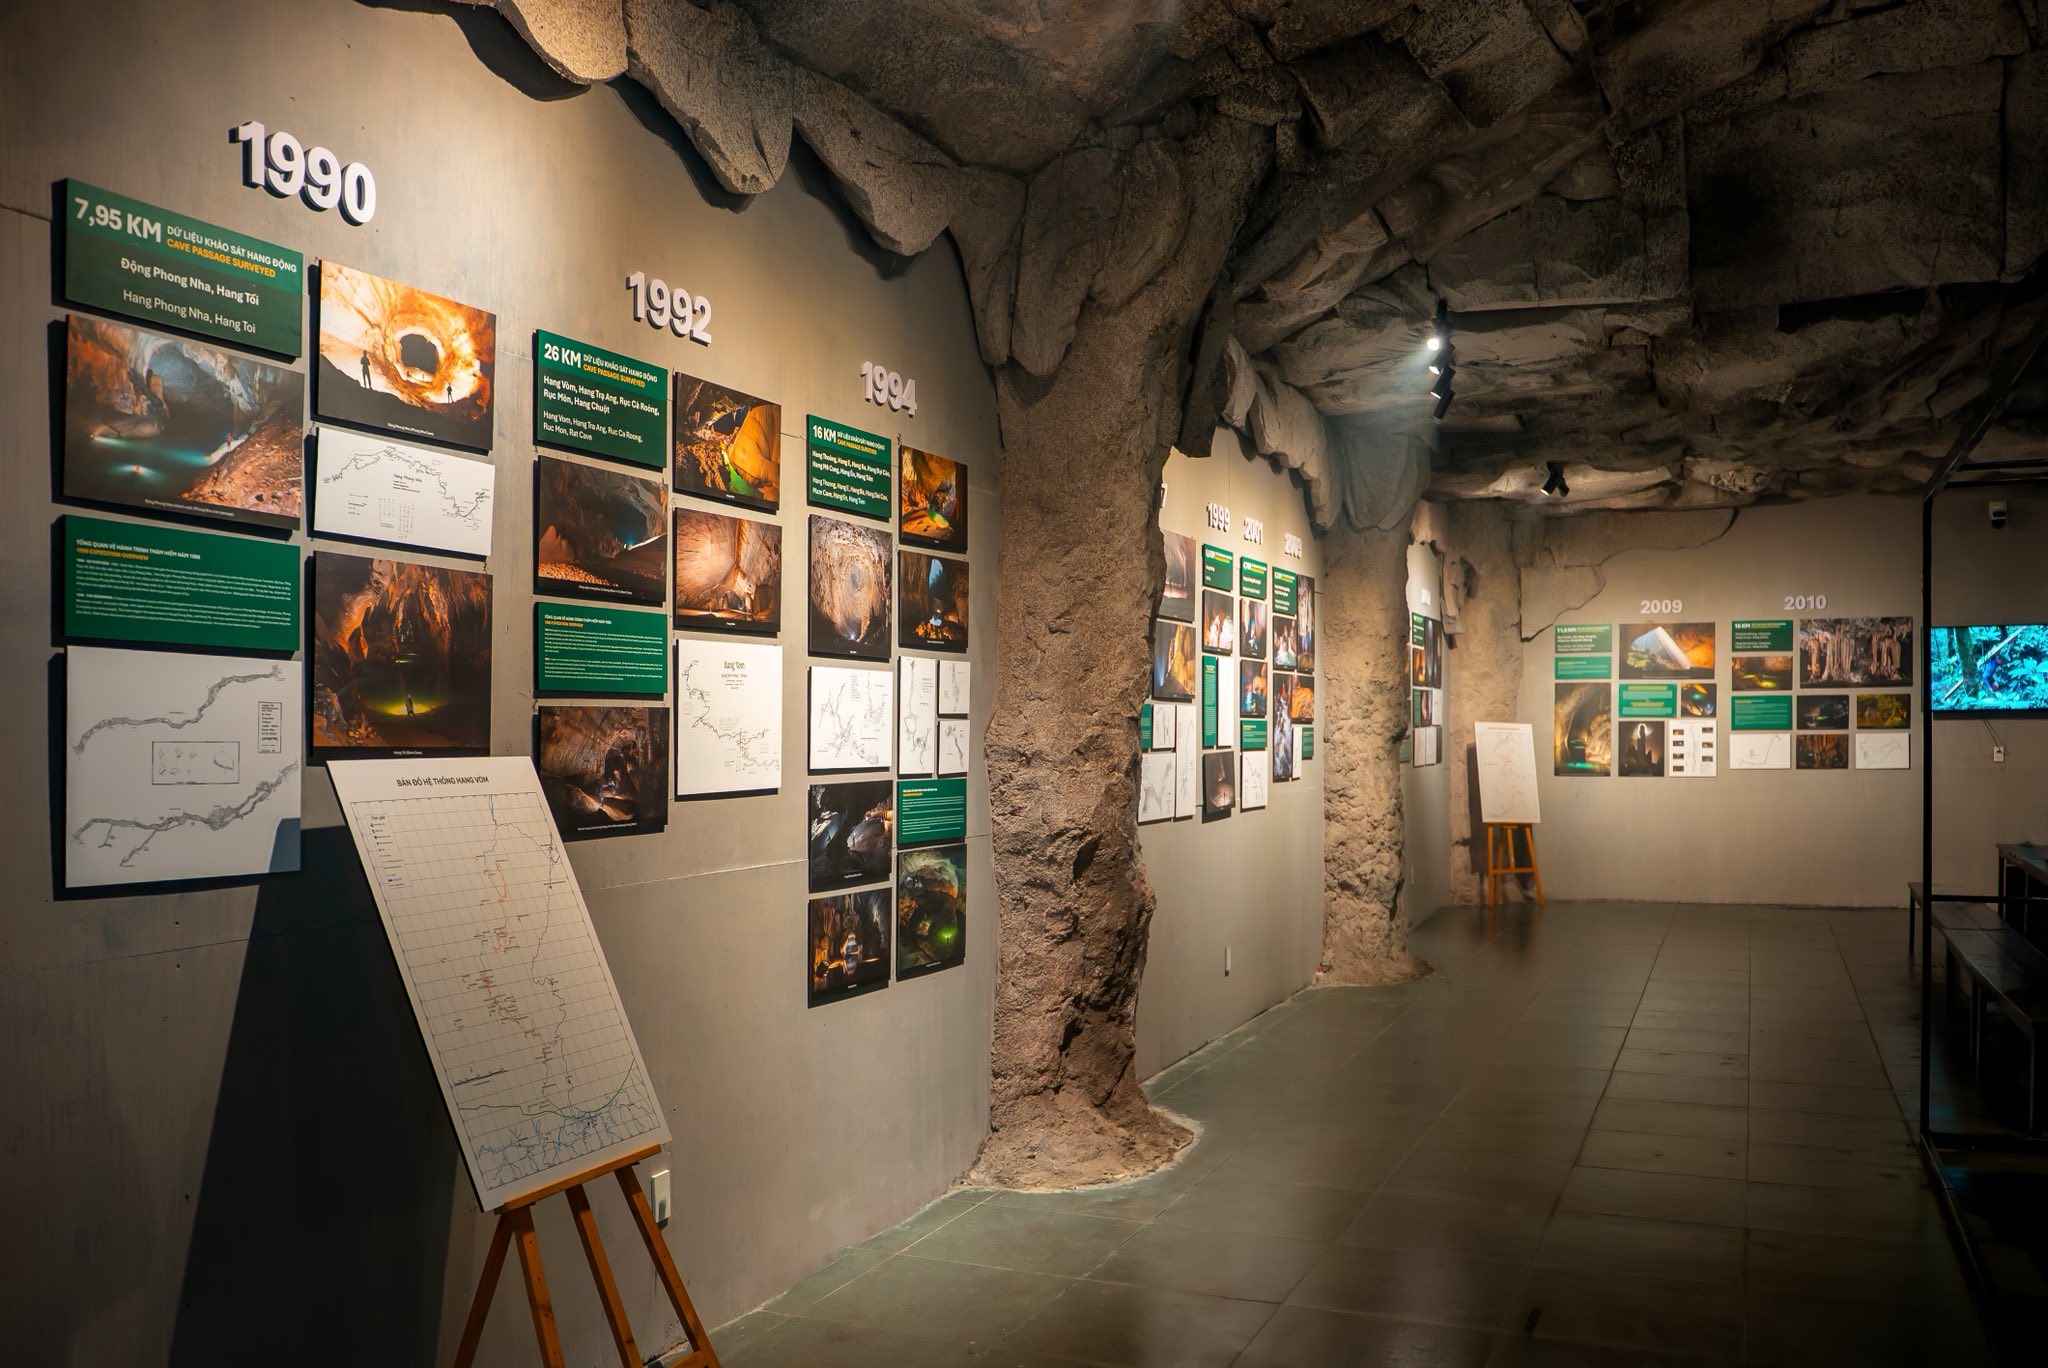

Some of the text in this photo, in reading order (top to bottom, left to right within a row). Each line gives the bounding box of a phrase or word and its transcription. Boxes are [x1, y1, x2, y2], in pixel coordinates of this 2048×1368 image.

[229, 121, 376, 226] 1990
[74, 197, 162, 243] 7,95 KM
[166, 238, 276, 278] CAVE PASSAGE SURVEYED
[183, 231, 203, 245] LIỆU
[204, 236, 229, 252] KHẢO
[231, 243, 246, 257] SÁT
[247, 250, 271, 265] HANG
[272, 258, 297, 273] ĐỘNG
[120, 257, 259, 306] Động Phong Nha, Hang Tối
[123, 289, 256, 334] Hang Phong Nha, Hang Toi
[626, 271, 712, 347] 1992
[544, 343, 581, 368] 26 KM
[583, 364, 597, 374] CAVE
[543, 375, 561, 389] Hang
[561, 380, 578, 394] Vòm,
[578, 385, 595, 399] Hang
[543, 388, 556, 401] Rục
[574, 397, 591, 411] Hang
[860, 361, 917, 418] 1994
[543, 411, 558, 423] Hang
[573, 418, 587, 430] Hang
[812, 424, 836, 443] 16 KM
[579, 431, 593, 441] Cave
[1206, 502, 1231, 533] 1999
[1244, 517, 1264, 546] 2001
[1640, 599, 1683, 615] 2009
[1784, 595, 1828, 611] 2010
[456, 776, 475, 784] HANG
